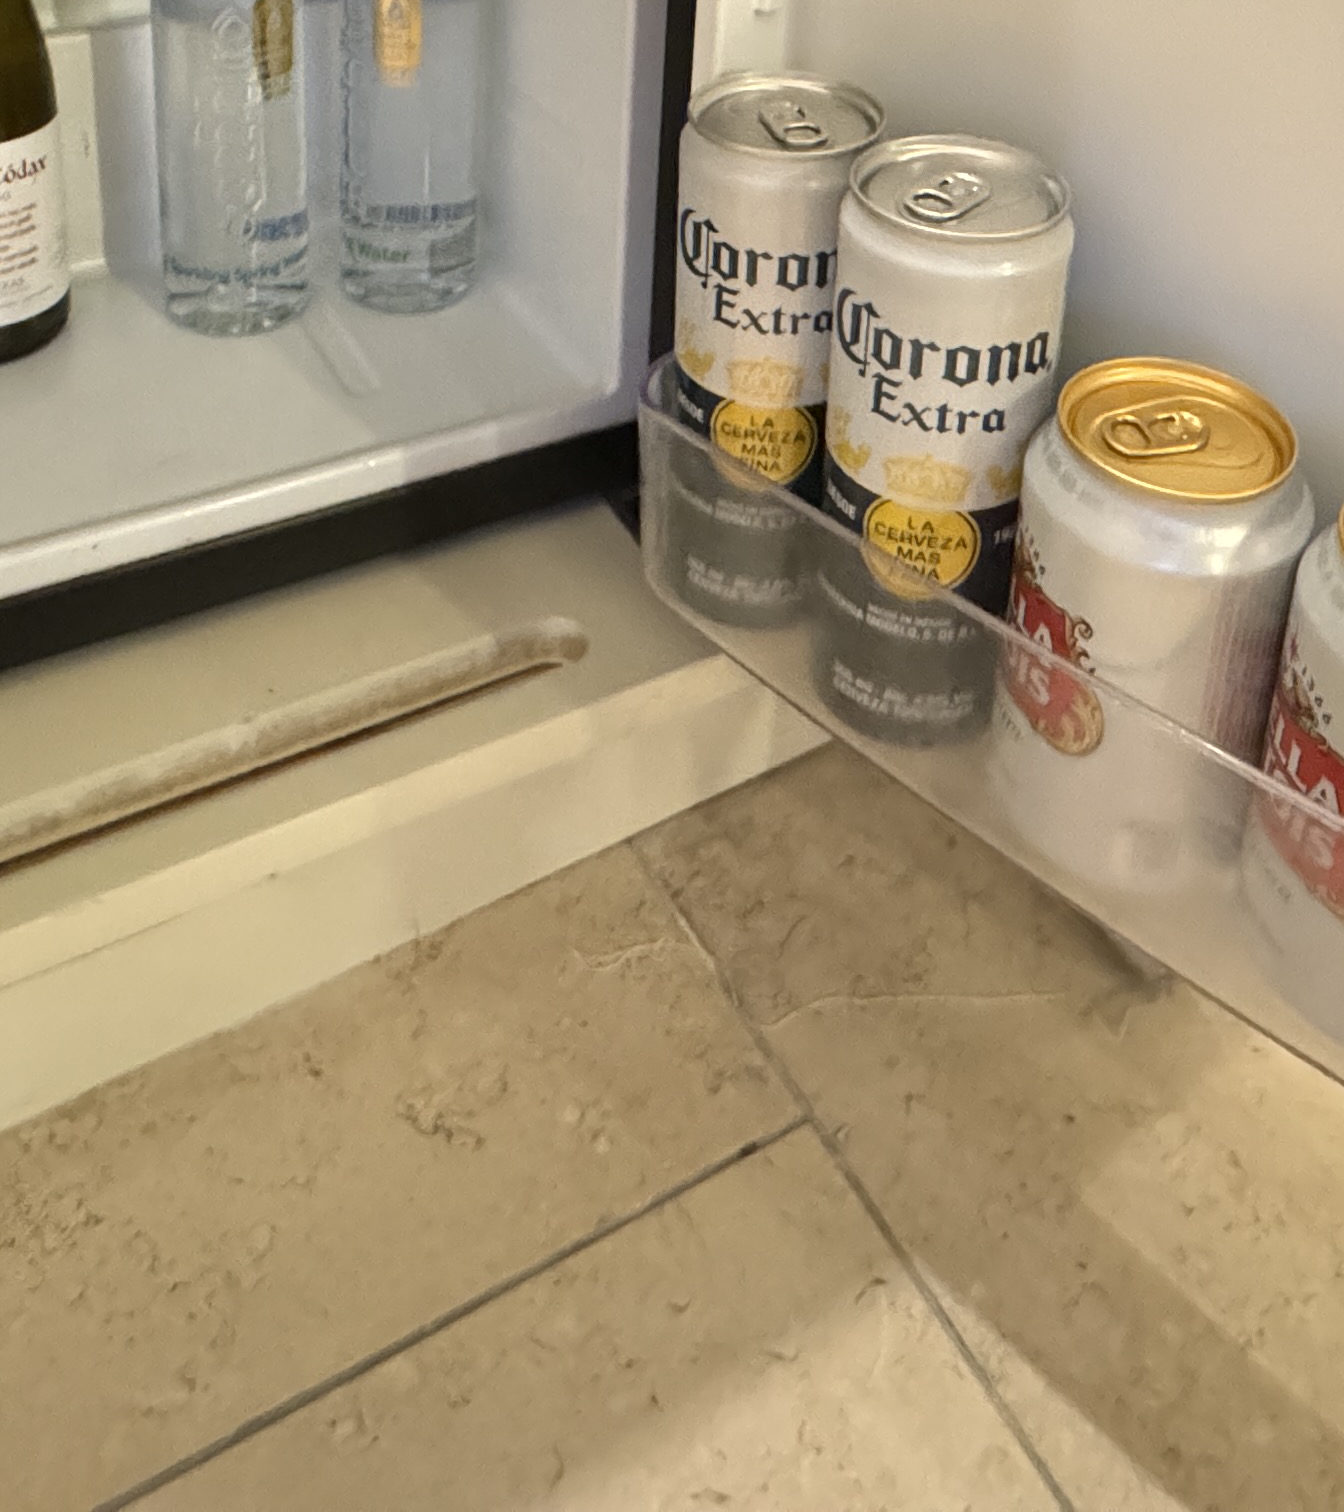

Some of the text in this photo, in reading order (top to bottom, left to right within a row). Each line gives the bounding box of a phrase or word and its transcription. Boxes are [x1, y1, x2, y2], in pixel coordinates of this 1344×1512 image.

[679, 208, 837, 290] Coron
[713, 283, 833, 336] Extra
[836, 288, 1050, 387] Corona
[870, 372, 1006, 436] Extra
[721, 420, 806, 445] CERVEZA
[750, 415, 775, 430] LA
[743, 457, 782, 472] INA
[874, 521, 968, 551] CERVEZA
[907, 516, 935, 534] LA
